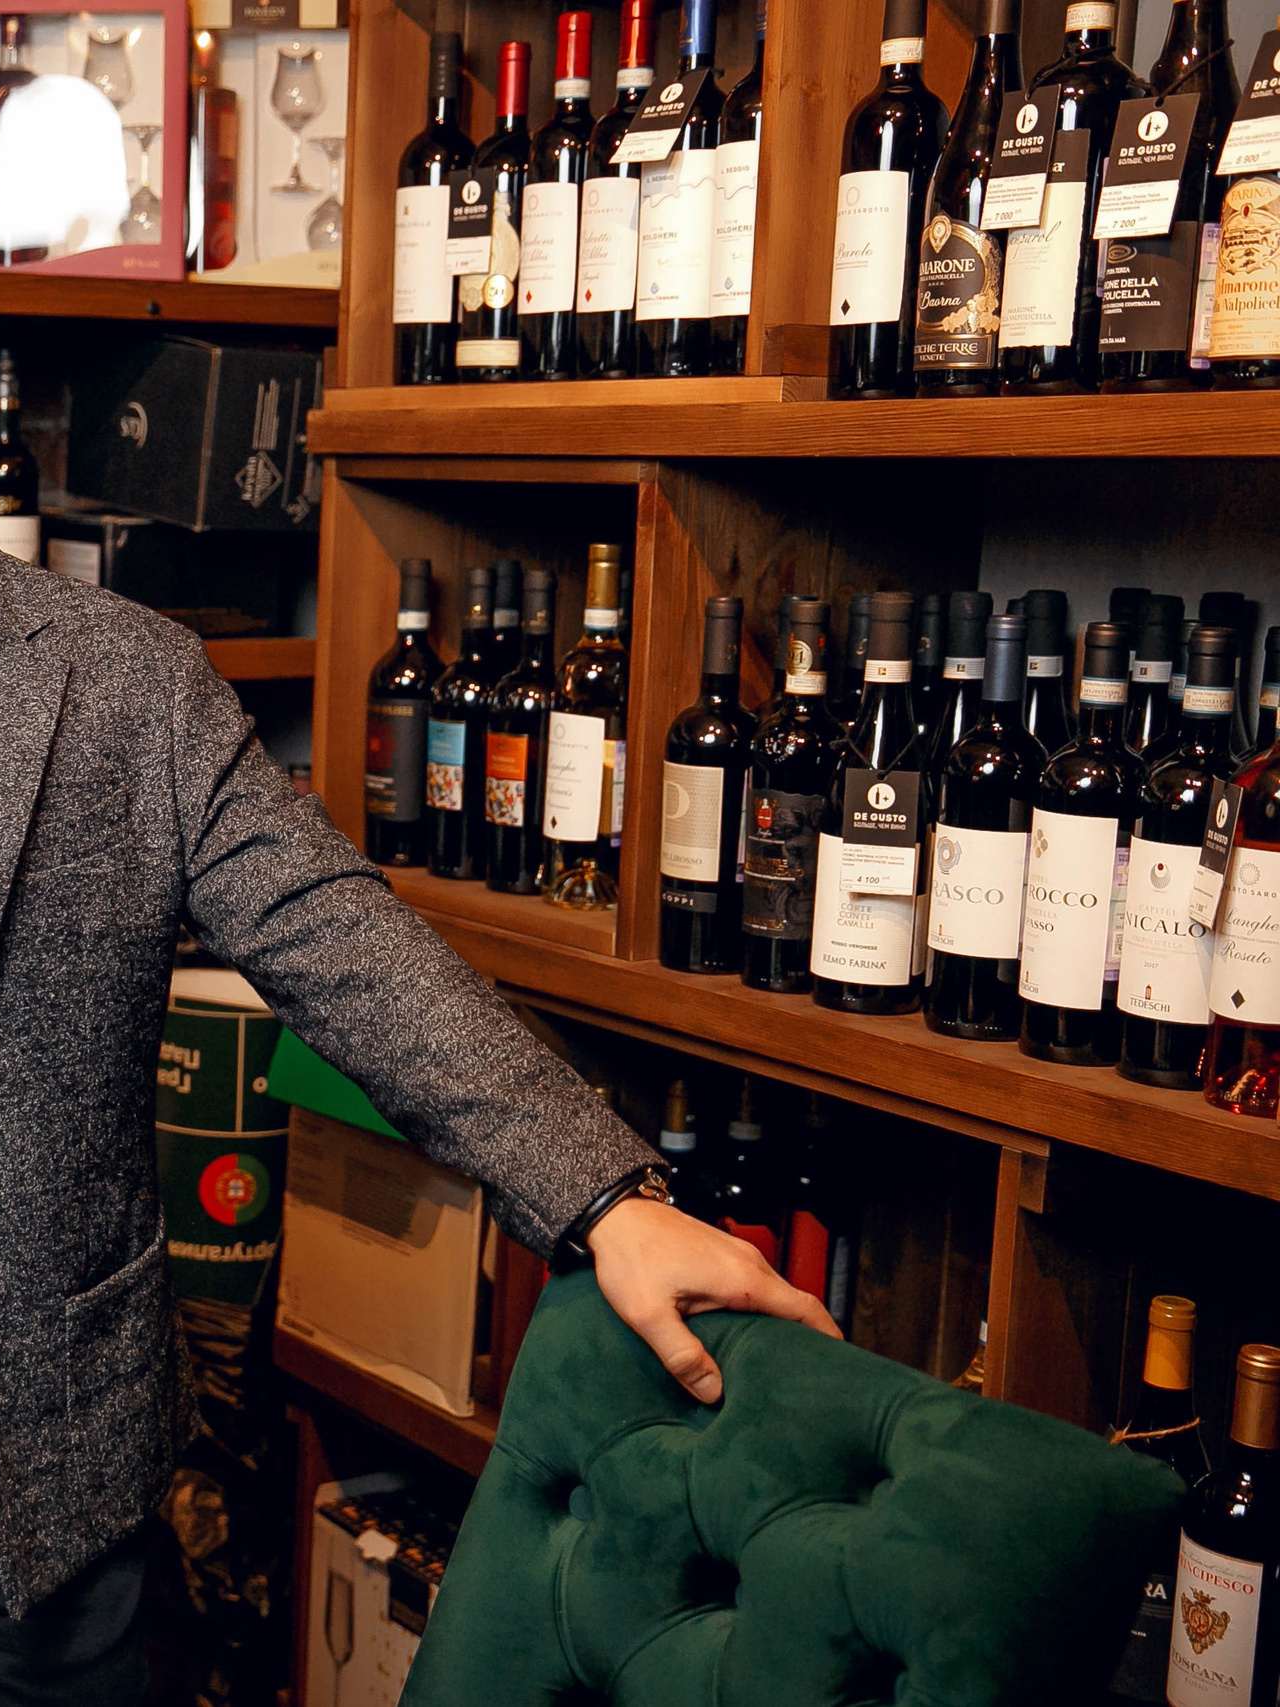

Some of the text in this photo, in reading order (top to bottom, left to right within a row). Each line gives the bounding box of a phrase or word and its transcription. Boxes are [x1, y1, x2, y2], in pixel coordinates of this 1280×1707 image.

[1253, 80, 1268, 90] DE
[644, 102, 685, 114] DE GUSTO
[1002, 136, 1044, 150] DE GUSTO
[1120, 142, 1176, 157] DE GUSTO
[1230, 186, 1273, 201] FARINA
[994, 212, 1014, 220] 7 000
[1112, 218, 1136, 228] 7 200
[836, 242, 874, 259] Barolo
[1121, 277, 1158, 288] DELLA
[938, 342, 978, 356] TERRE
[854, 812, 906, 822] DE GUSTO
[865, 876, 880, 884] 100
[840, 902, 872, 913] CORTE
[1138, 904, 1176, 916] CAPITEL
[839, 911, 870, 920] CONTI
[836, 918, 874, 930] CAVALLI
[1226, 908, 1280, 936] Langhe
[1220, 938, 1272, 964] Rosato
[822, 954, 846, 966] REMO
[1130, 997, 1171, 1012] TEDESCHI
[1171, 1646, 1238, 1688] TOSCANA
